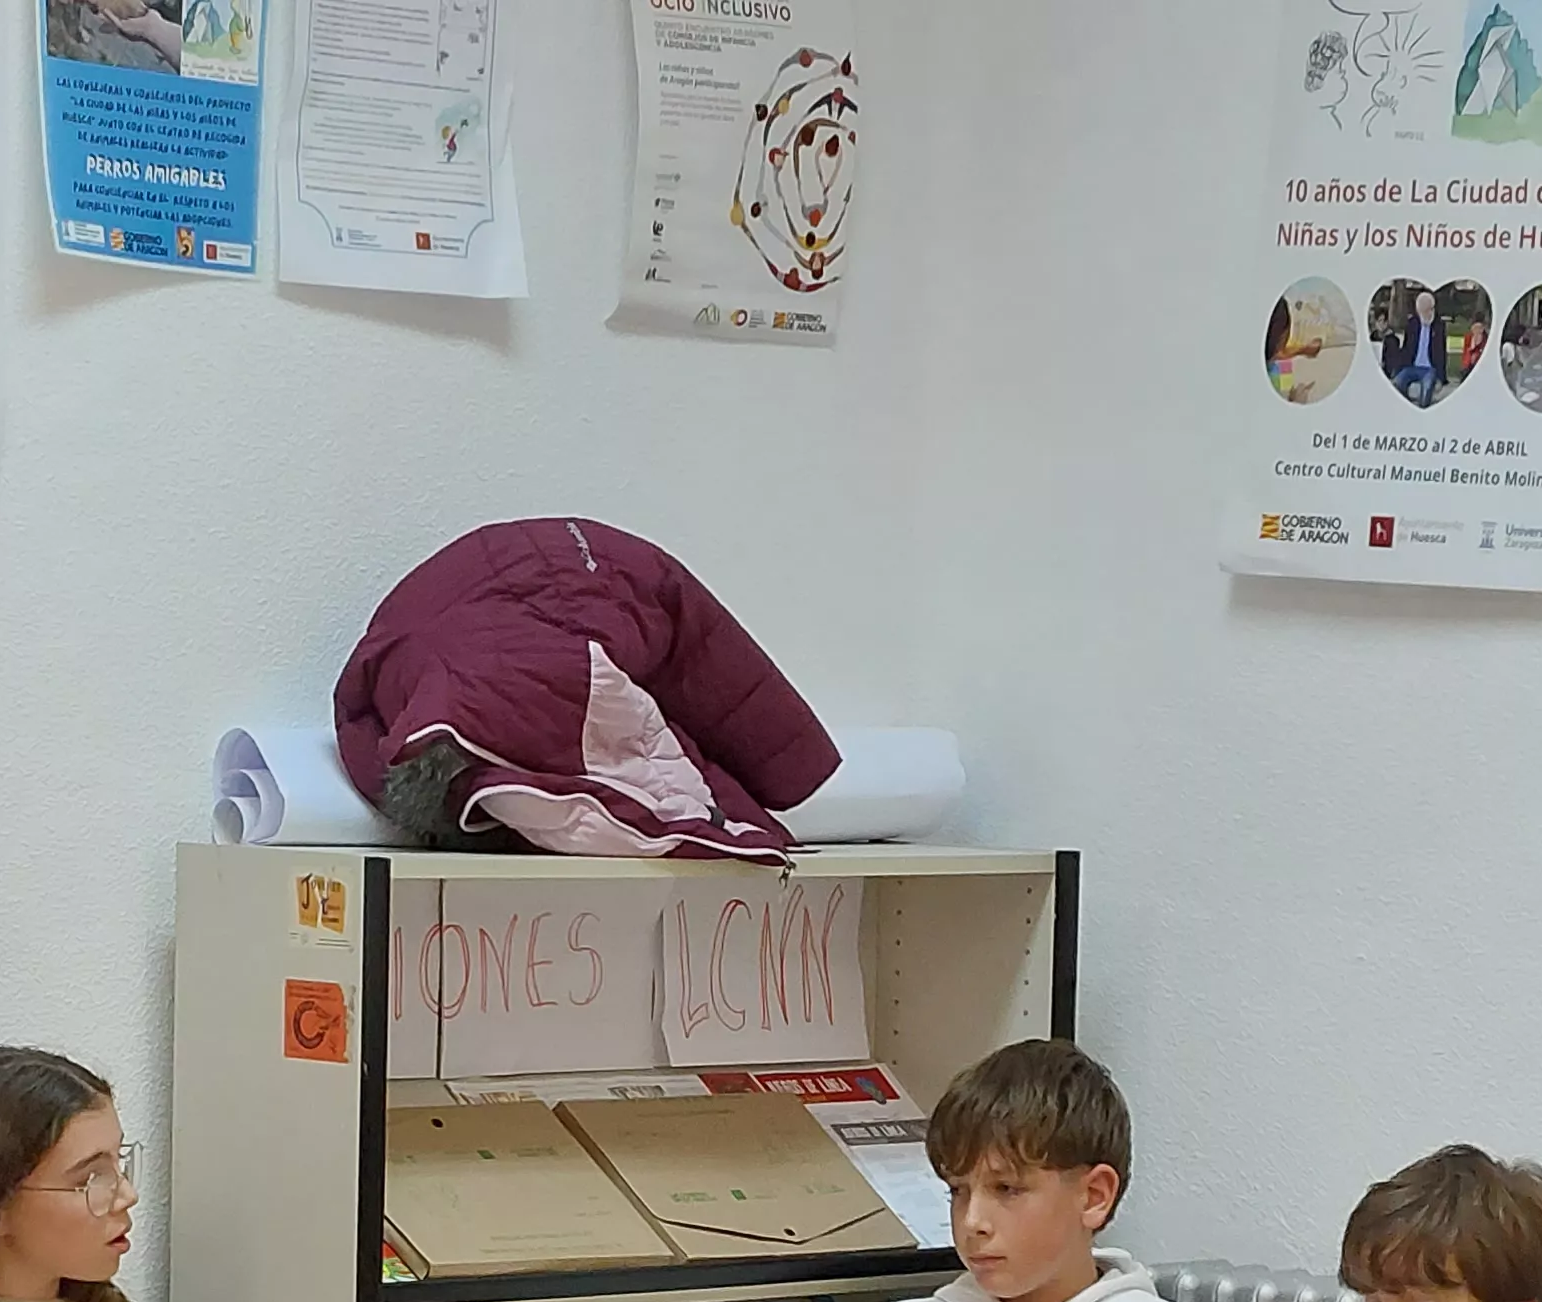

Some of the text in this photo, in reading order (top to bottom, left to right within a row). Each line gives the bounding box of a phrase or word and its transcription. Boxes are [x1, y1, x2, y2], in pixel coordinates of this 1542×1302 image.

[702, 0, 791, 21] INCLUSIVO
[86, 97, 114, 111] CIUDAD
[116, 102, 126, 113] DE
[128, 103, 145, 116] LAS
[181, 112, 197, 123] LOS
[226, 115, 236, 127] DE
[188, 95, 203, 106] DEL
[206, 97, 251, 112] PROYECTO
[157, 125, 189, 139] CENTRO
[192, 129, 202, 141] DE
[86, 153, 226, 190] PERROS AMIGABLES
[74, 182, 93, 194] PARA
[173, 195, 209, 209] RESPETO
[1285, 179, 1308, 203] 10
[1313, 178, 1367, 205] años
[1373, 178, 1402, 204] de
[1411, 179, 1438, 205] La
[1446, 179, 1528, 206] Ciudad
[1276, 220, 1339, 248] Niñas
[1344, 230, 1359, 255] y
[1364, 222, 1398, 249] los
[1406, 222, 1476, 250] Niños
[1483, 225, 1512, 250] de
[1312, 432, 1528, 458] Del 1 de MARZO al 2 de ABRIL
[1274, 460, 1324, 479] Centro
[1326, 461, 1386, 481] Cultural
[1389, 463, 1446, 484] Manuel
[1450, 466, 1500, 486] Benito
[1281, 514, 1342, 529] GOBIERNO
[1280, 528, 1349, 544] DE ARAGON
[1410, 531, 1447, 544] Huesca
[676, 884, 844, 1038] LCNN
